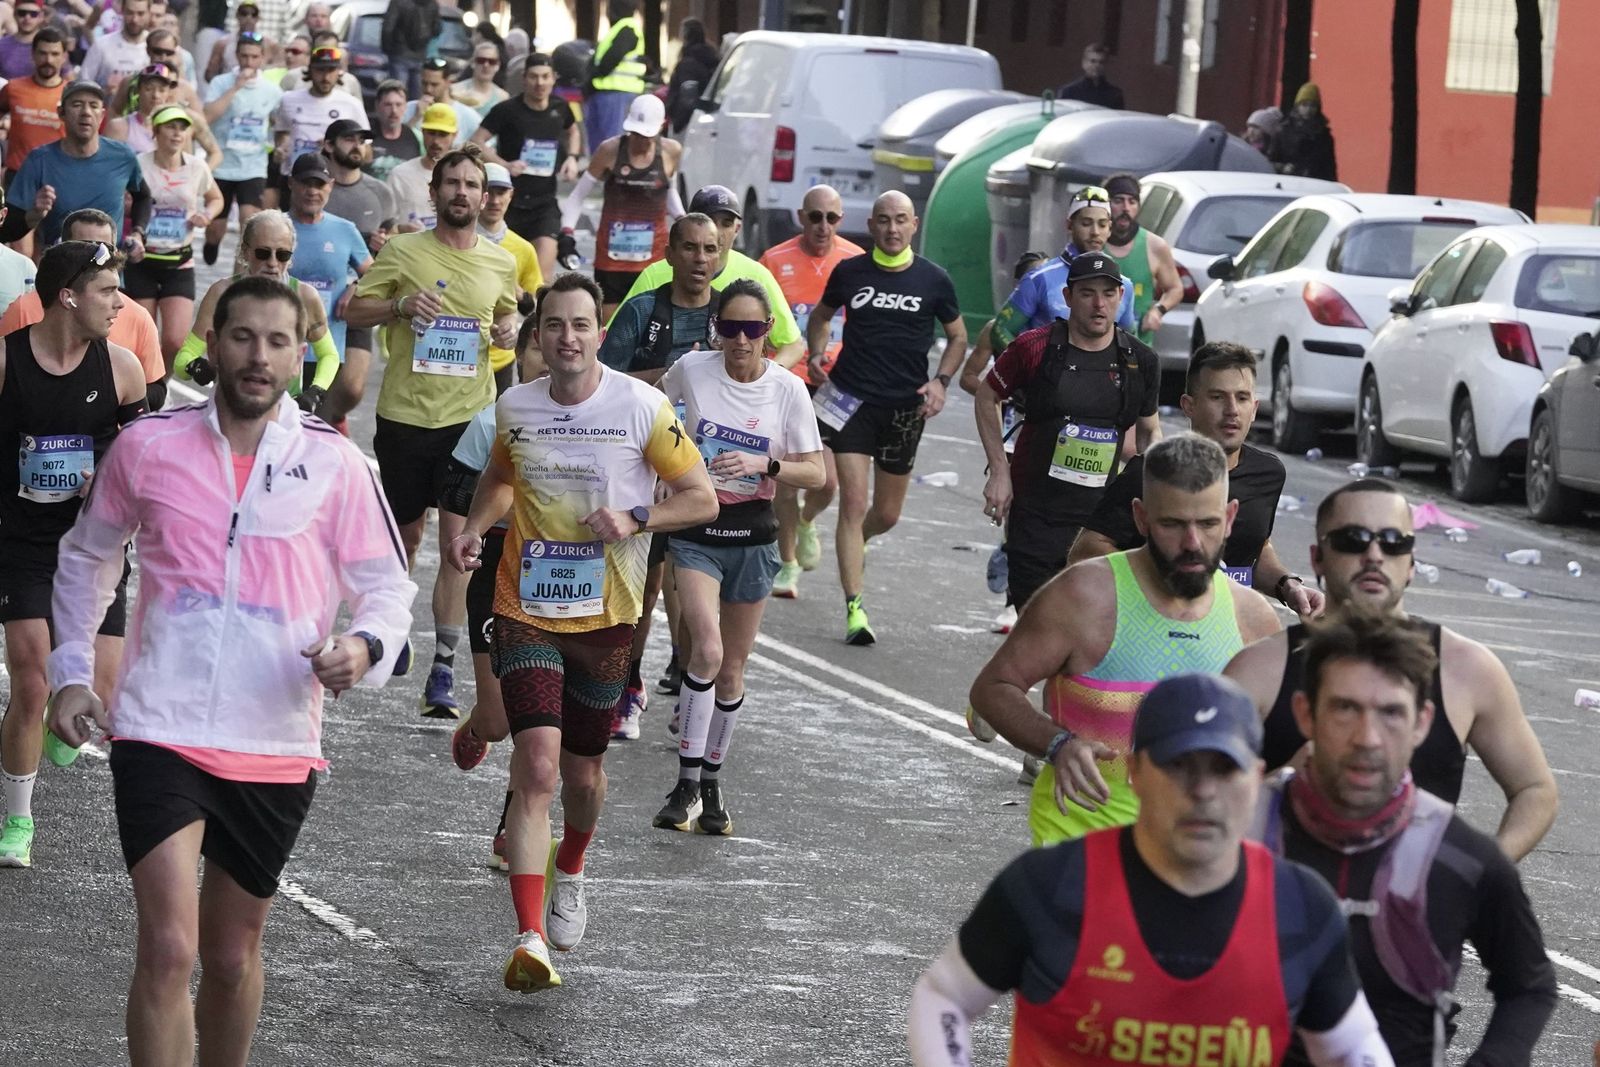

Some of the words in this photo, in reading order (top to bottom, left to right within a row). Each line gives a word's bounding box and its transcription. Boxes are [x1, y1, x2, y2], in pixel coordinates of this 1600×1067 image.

[439, 319, 474, 330] ZURICH
[439, 336, 458, 346] 7757
[428, 347, 465, 362] MARTI
[537, 427, 566, 436] RETO
[569, 427, 627, 437] SOLIDARIO
[1082, 429, 1113, 440] ZURICH
[720, 429, 761, 448] ZURICH
[1080, 447, 1098, 457] 1516
[42, 460, 65, 470] 9072
[524, 464, 549, 473] Vuelta
[1064, 455, 1103, 473] DIEGOL
[31, 472, 78, 488] PEDRO
[705, 528, 751, 537] SALOMON
[550, 545, 594, 556] ZURICH
[550, 568, 576, 579] 6825
[531, 582, 592, 599] JUANJO
[1109, 1016, 1273, 1067] SESEÑA
